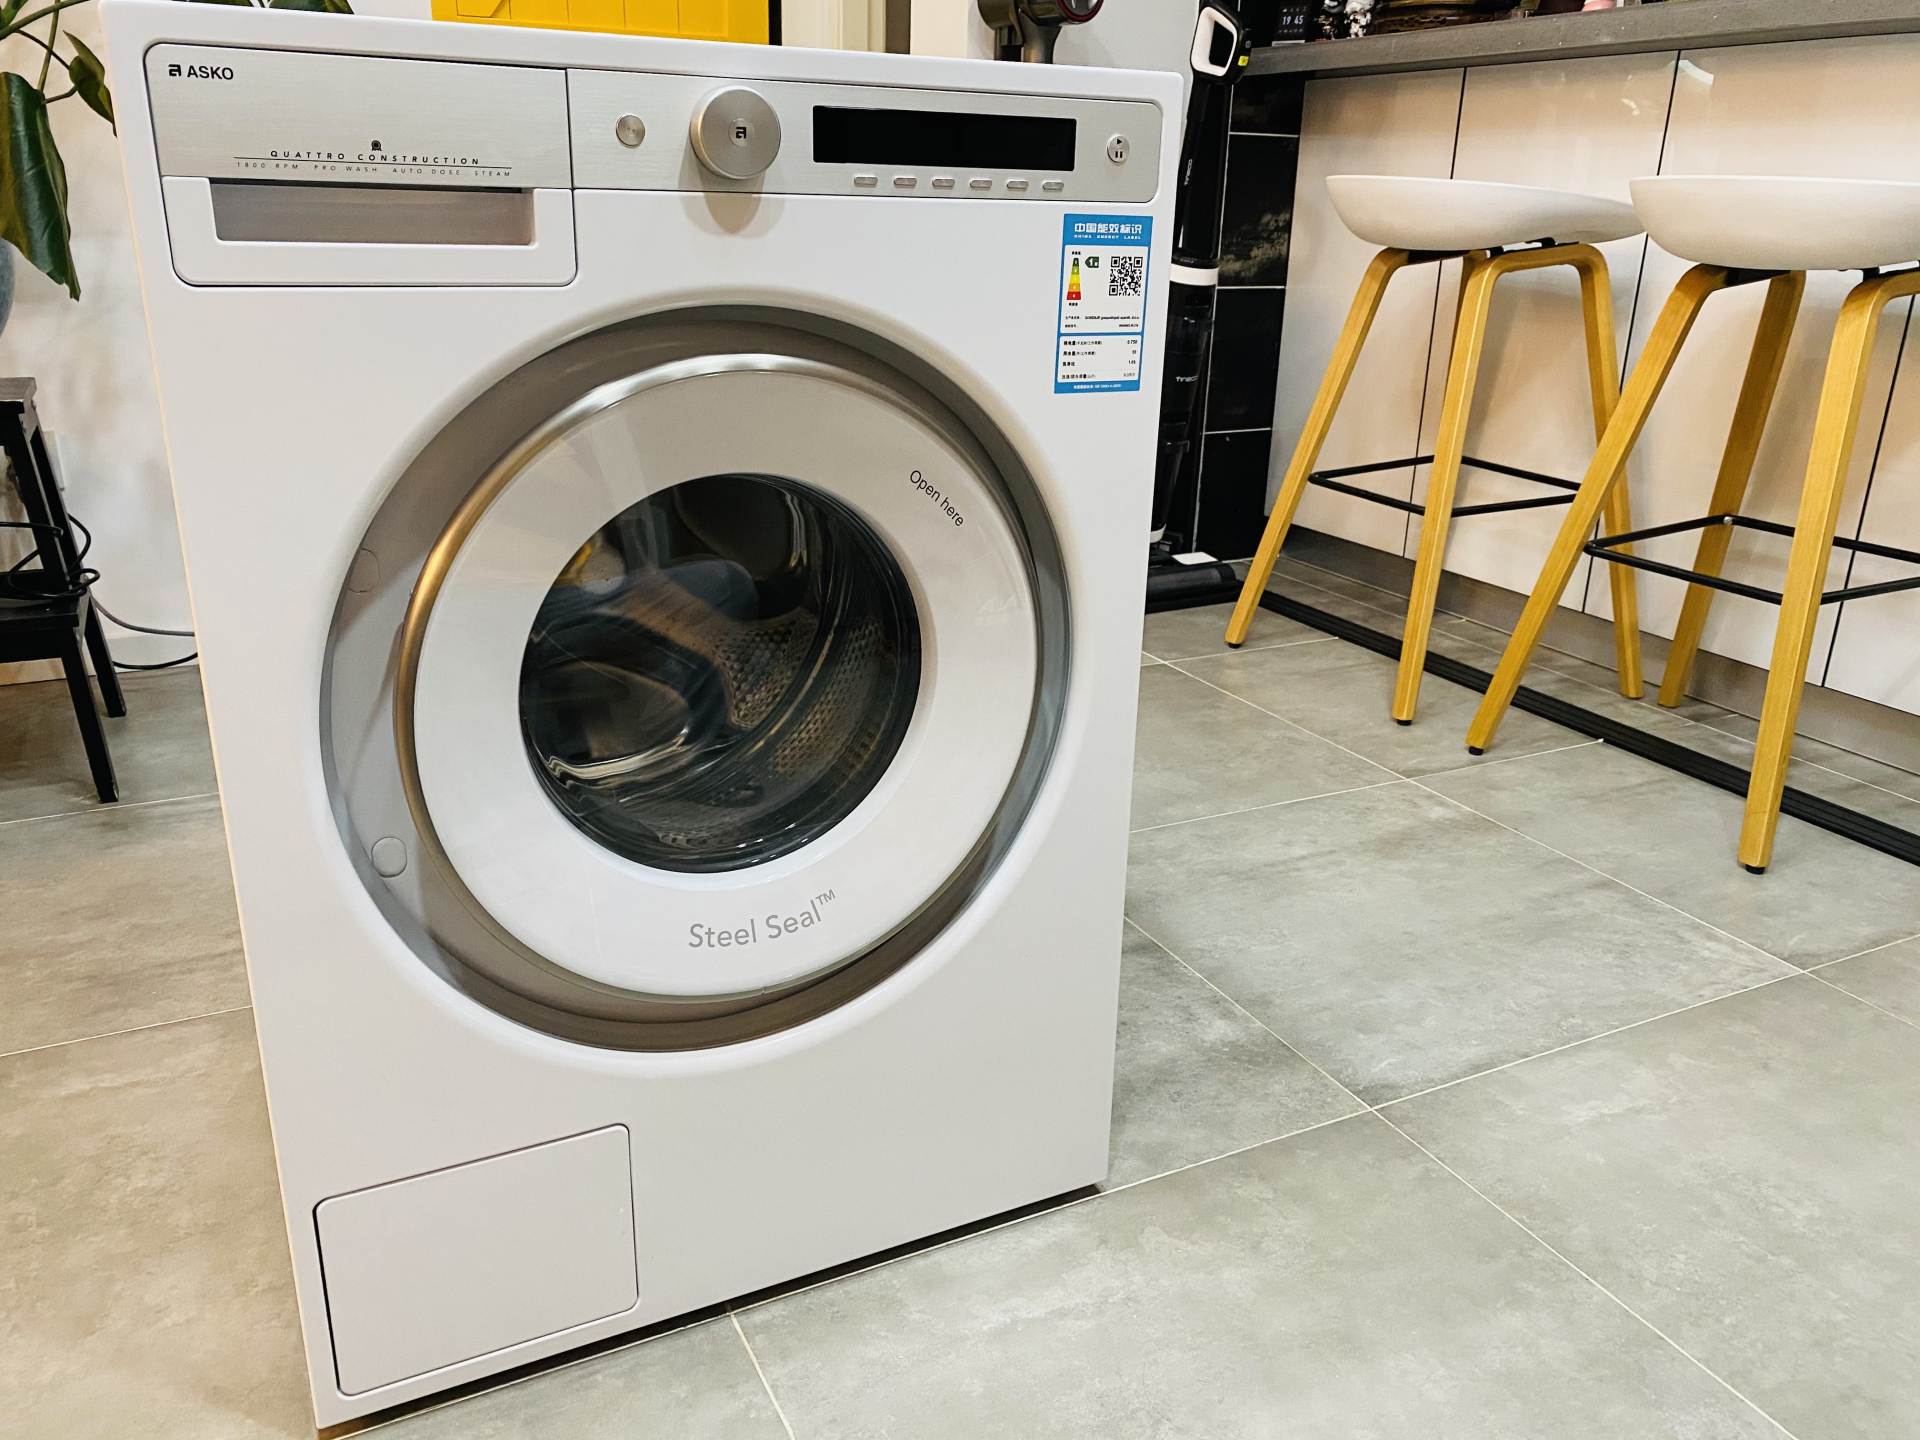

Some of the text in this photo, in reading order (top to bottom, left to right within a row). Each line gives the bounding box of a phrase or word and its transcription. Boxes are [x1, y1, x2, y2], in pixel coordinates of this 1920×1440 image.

[1282, 15, 1292, 25] 19
[187, 65, 234, 80] ASKO
[270, 150, 479, 165] QUATTRO CONSTRUCTION
[1074, 222, 1142, 234] 中国能效标识
[910, 470, 964, 526] Open here
[688, 918, 757, 948] Steel
